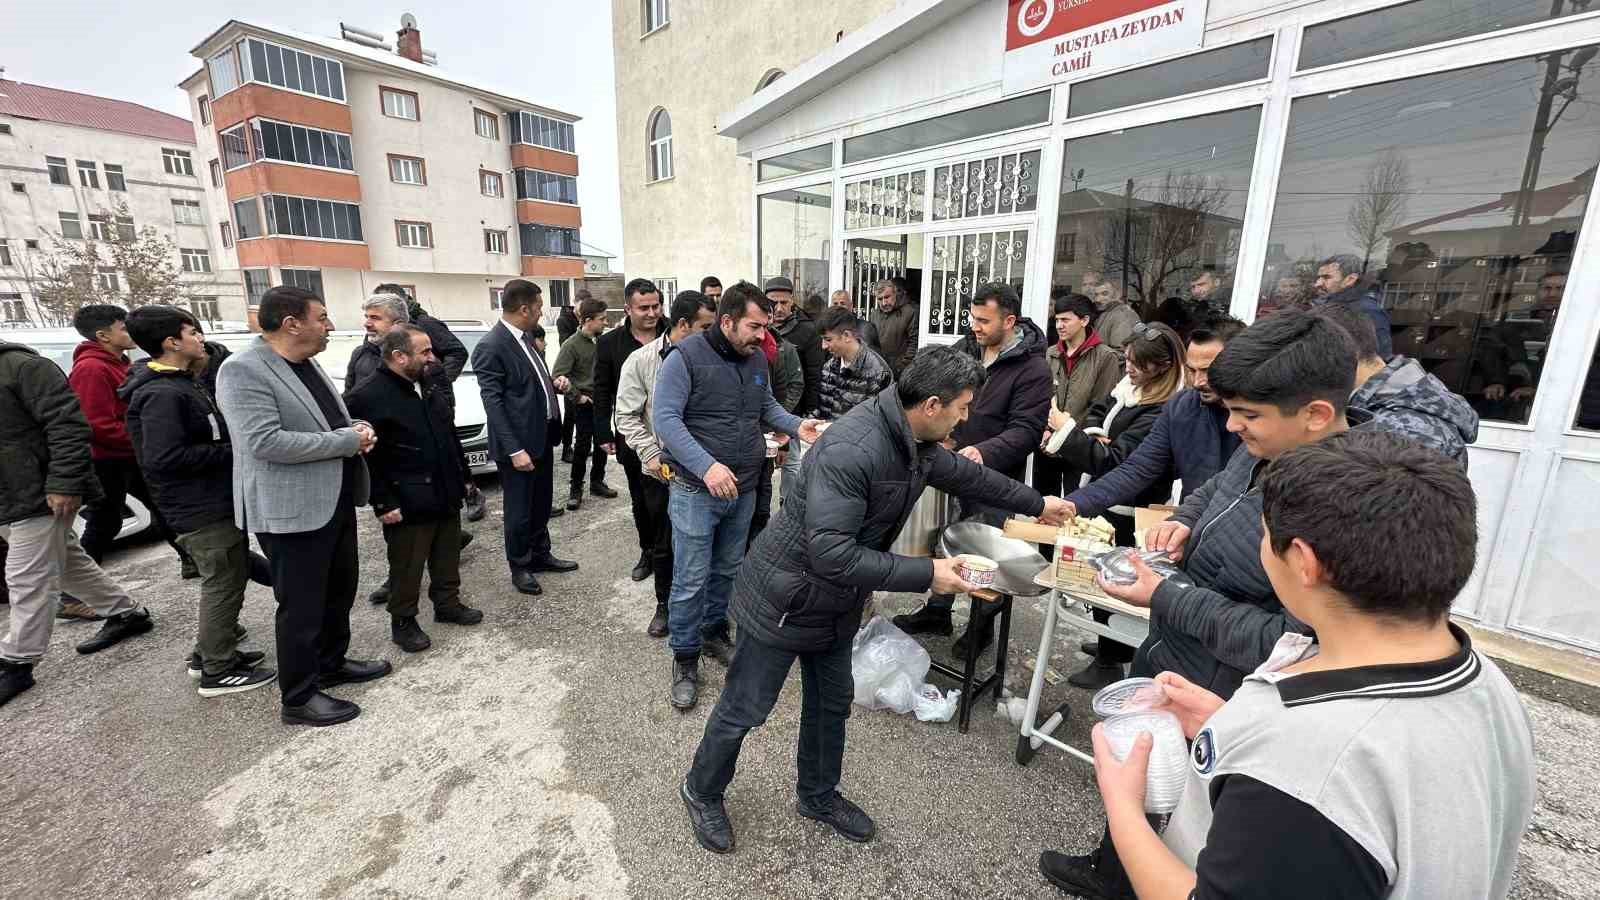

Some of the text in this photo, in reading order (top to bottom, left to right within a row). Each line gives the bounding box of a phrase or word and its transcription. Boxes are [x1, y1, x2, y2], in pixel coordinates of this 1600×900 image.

[1054, 8, 1184, 56] MUSTAFA ZEYDAN
[1052, 51, 1091, 76] CAMİİ
